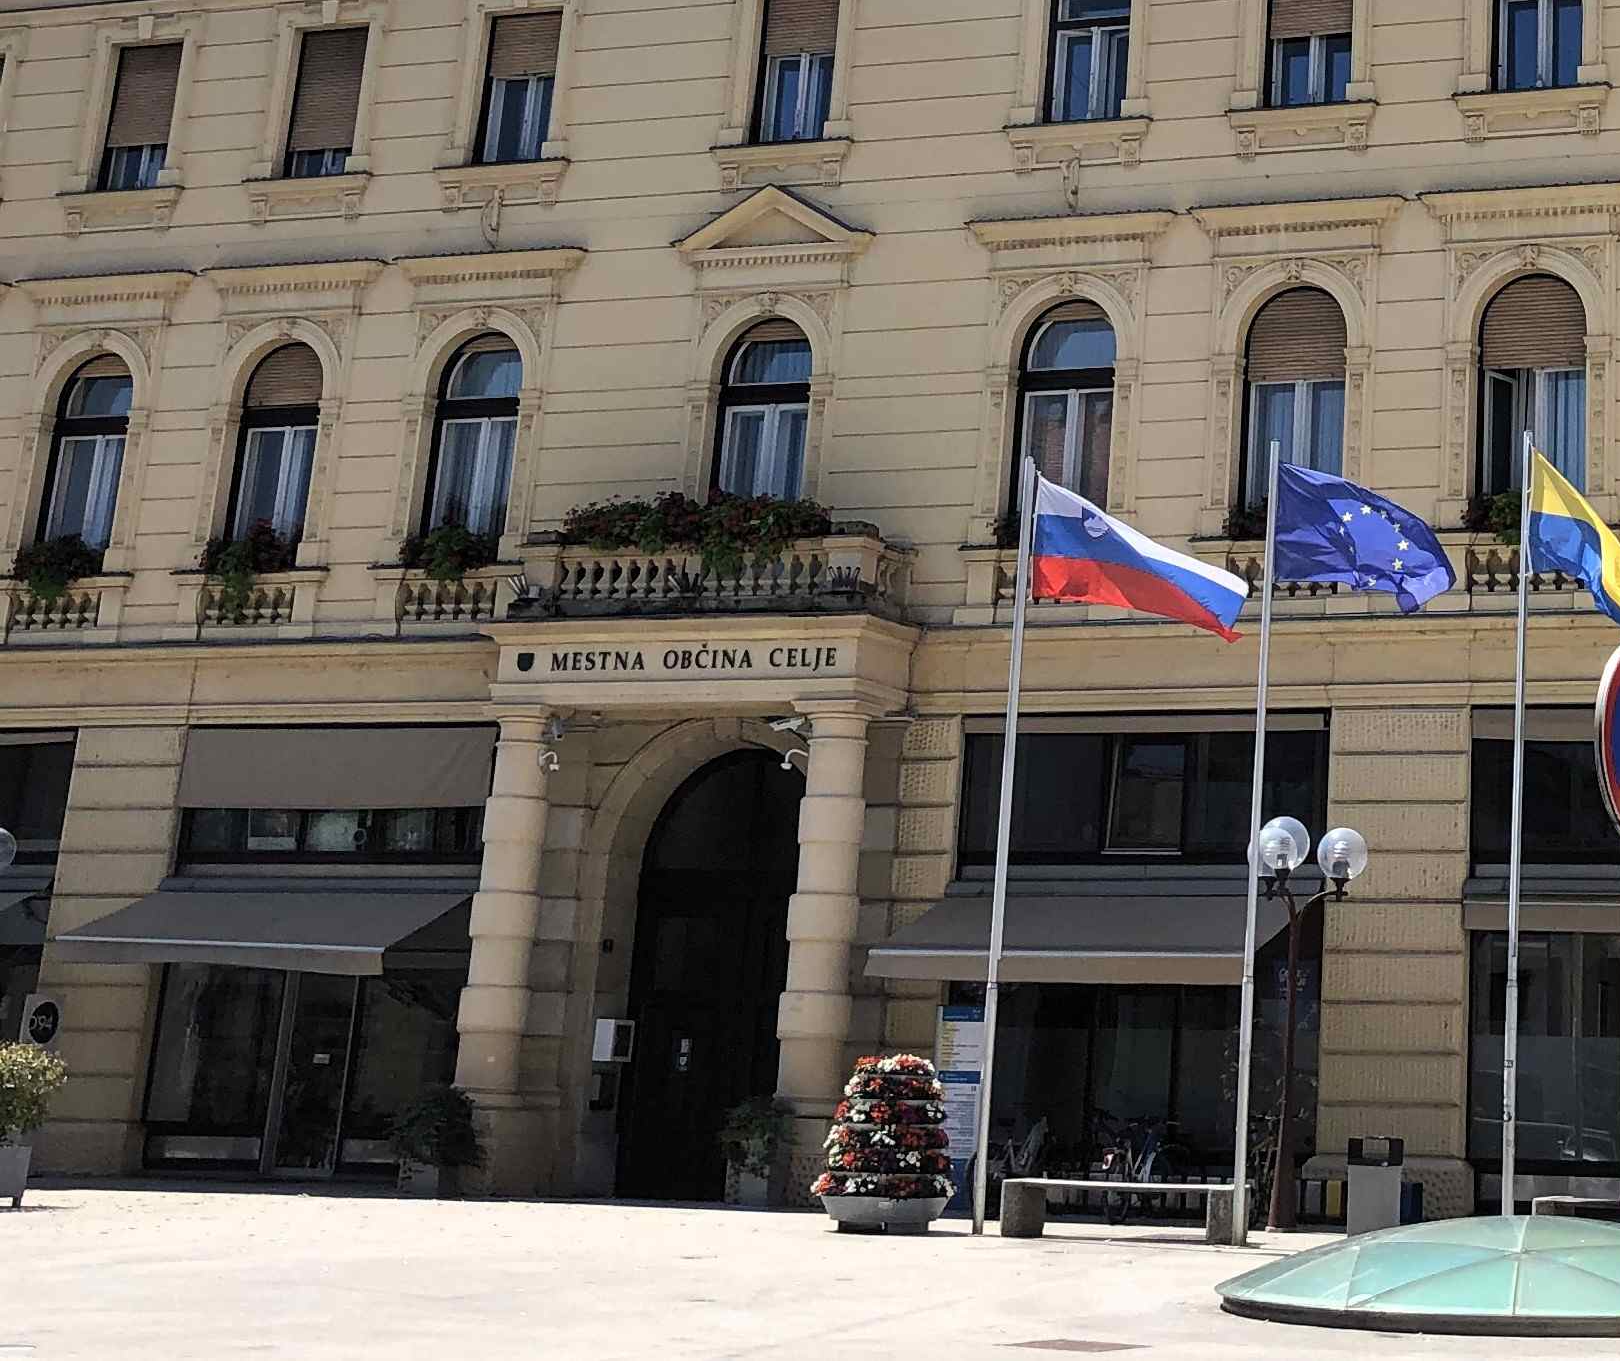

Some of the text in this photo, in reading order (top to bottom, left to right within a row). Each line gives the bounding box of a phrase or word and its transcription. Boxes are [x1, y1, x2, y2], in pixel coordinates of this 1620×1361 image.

[550, 643, 837, 672] MESTNA OBČINA CELJE
